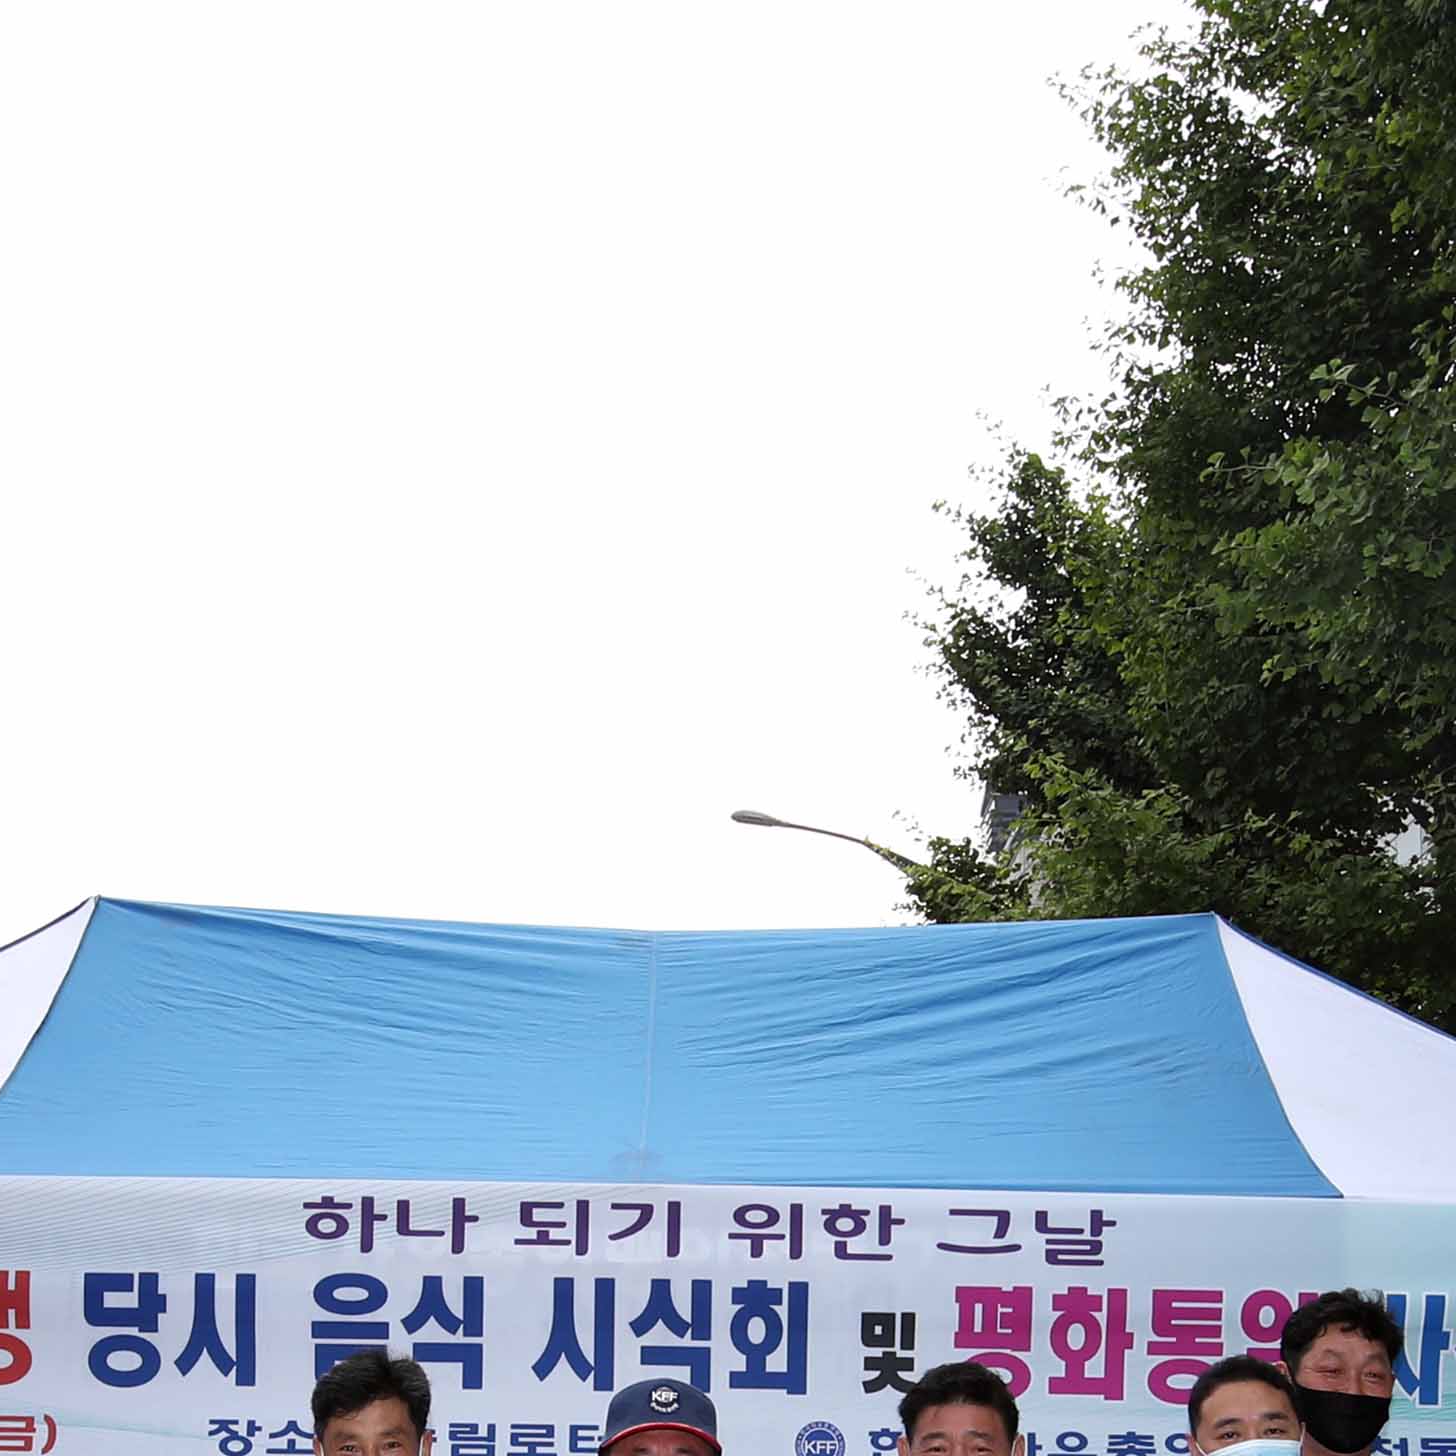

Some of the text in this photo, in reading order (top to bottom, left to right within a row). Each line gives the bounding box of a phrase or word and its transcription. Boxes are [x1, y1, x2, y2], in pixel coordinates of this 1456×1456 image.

[303, 1197, 1116, 1266] 하나 되기 위한 그날
[83, 1272, 256, 1387] 당시
[310, 1273, 484, 1389] 음식
[532, 1277, 810, 1395] 시식회
[861, 1312, 915, 1394] 및
[651, 1390, 678, 1402] KFF
[208, 1418, 314, 1456] 장소
[804, 1440, 837, 1454] KFF
